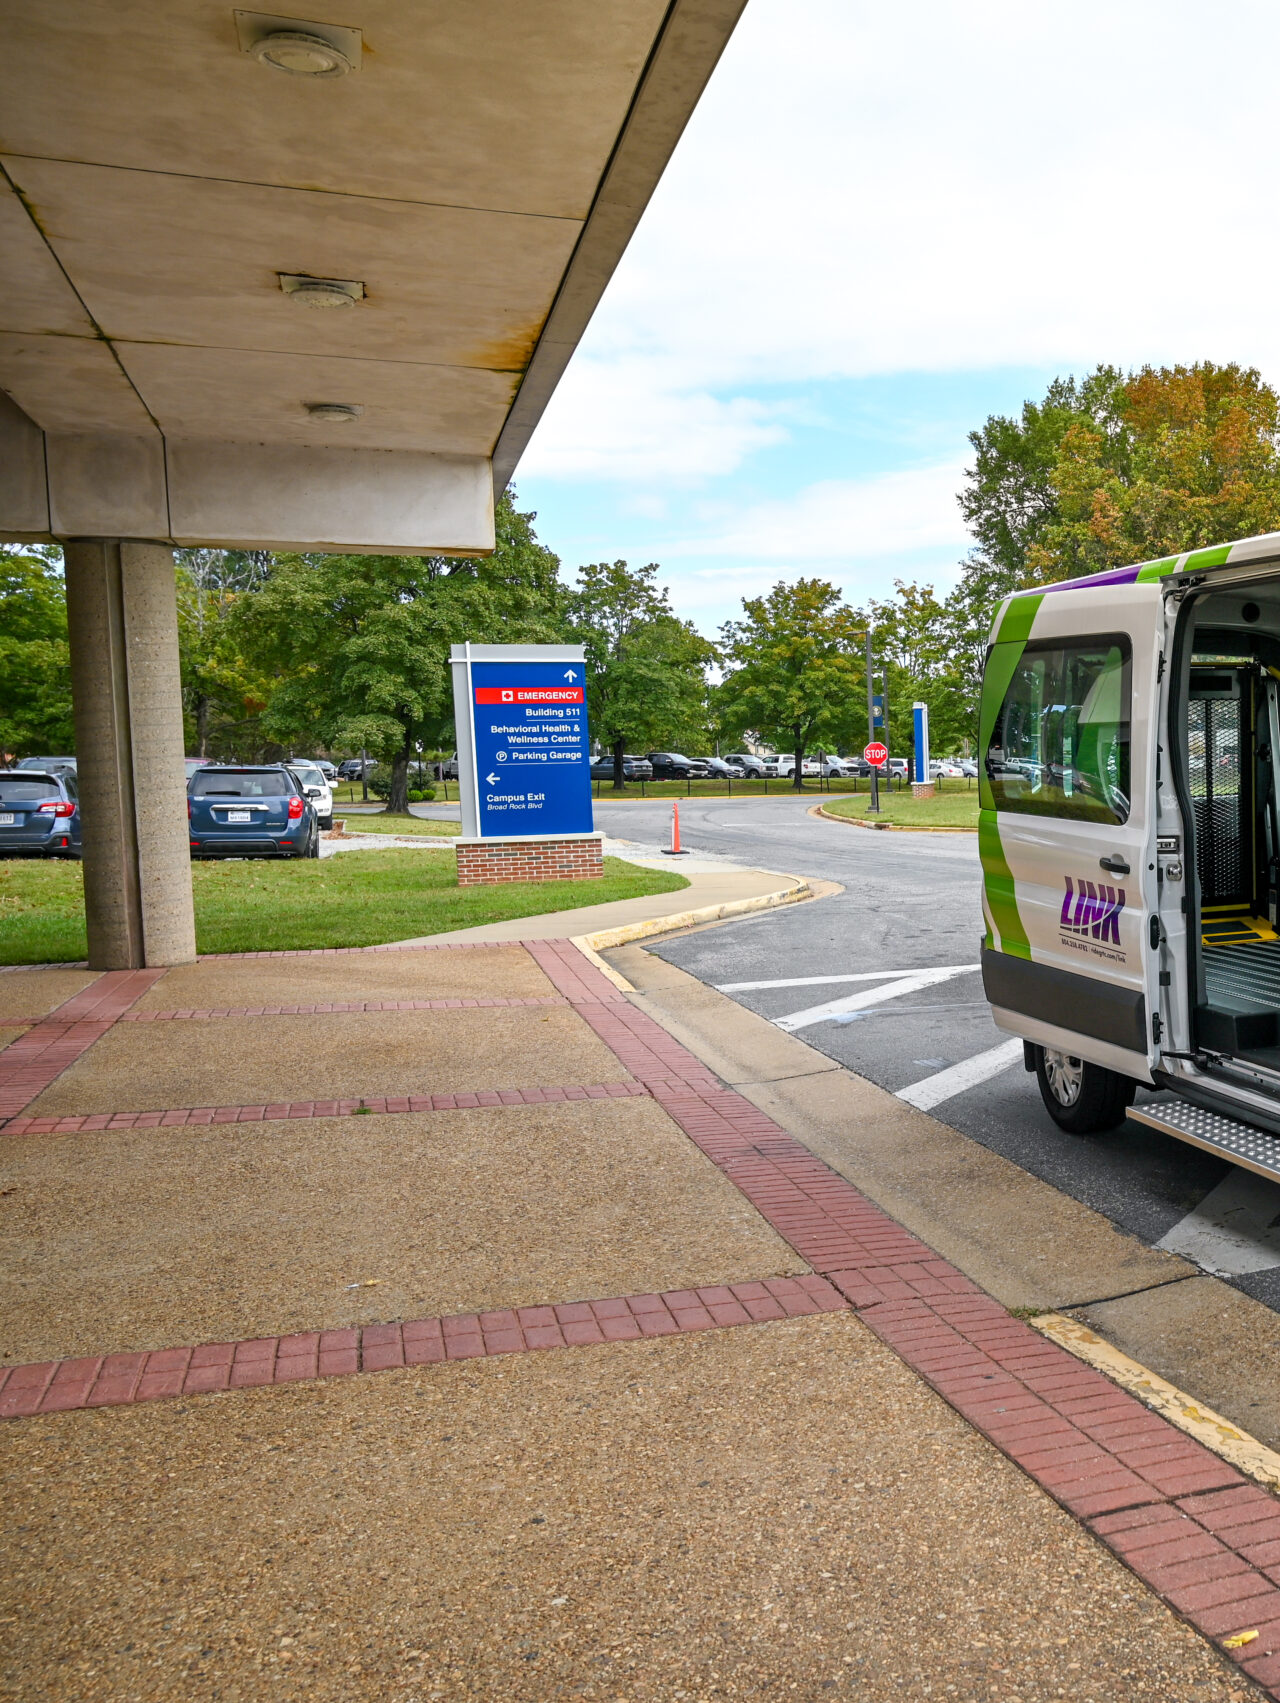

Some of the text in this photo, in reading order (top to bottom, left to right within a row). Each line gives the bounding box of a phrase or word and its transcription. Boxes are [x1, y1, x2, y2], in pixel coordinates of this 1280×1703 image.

[518, 692, 578, 700] EMERGENCY
[526, 708, 580, 717] Building 511
[491, 724, 580, 734] Behavioral Health &
[507, 734, 581, 744] Wellness Center
[512, 752, 547, 761] Parking
[549, 751, 582, 760] Garage
[865, 749, 886, 759] STOP
[487, 793, 545, 803] Campus Exit
[487, 803, 508, 811] Broad
[1060, 876, 1126, 946] LINK
